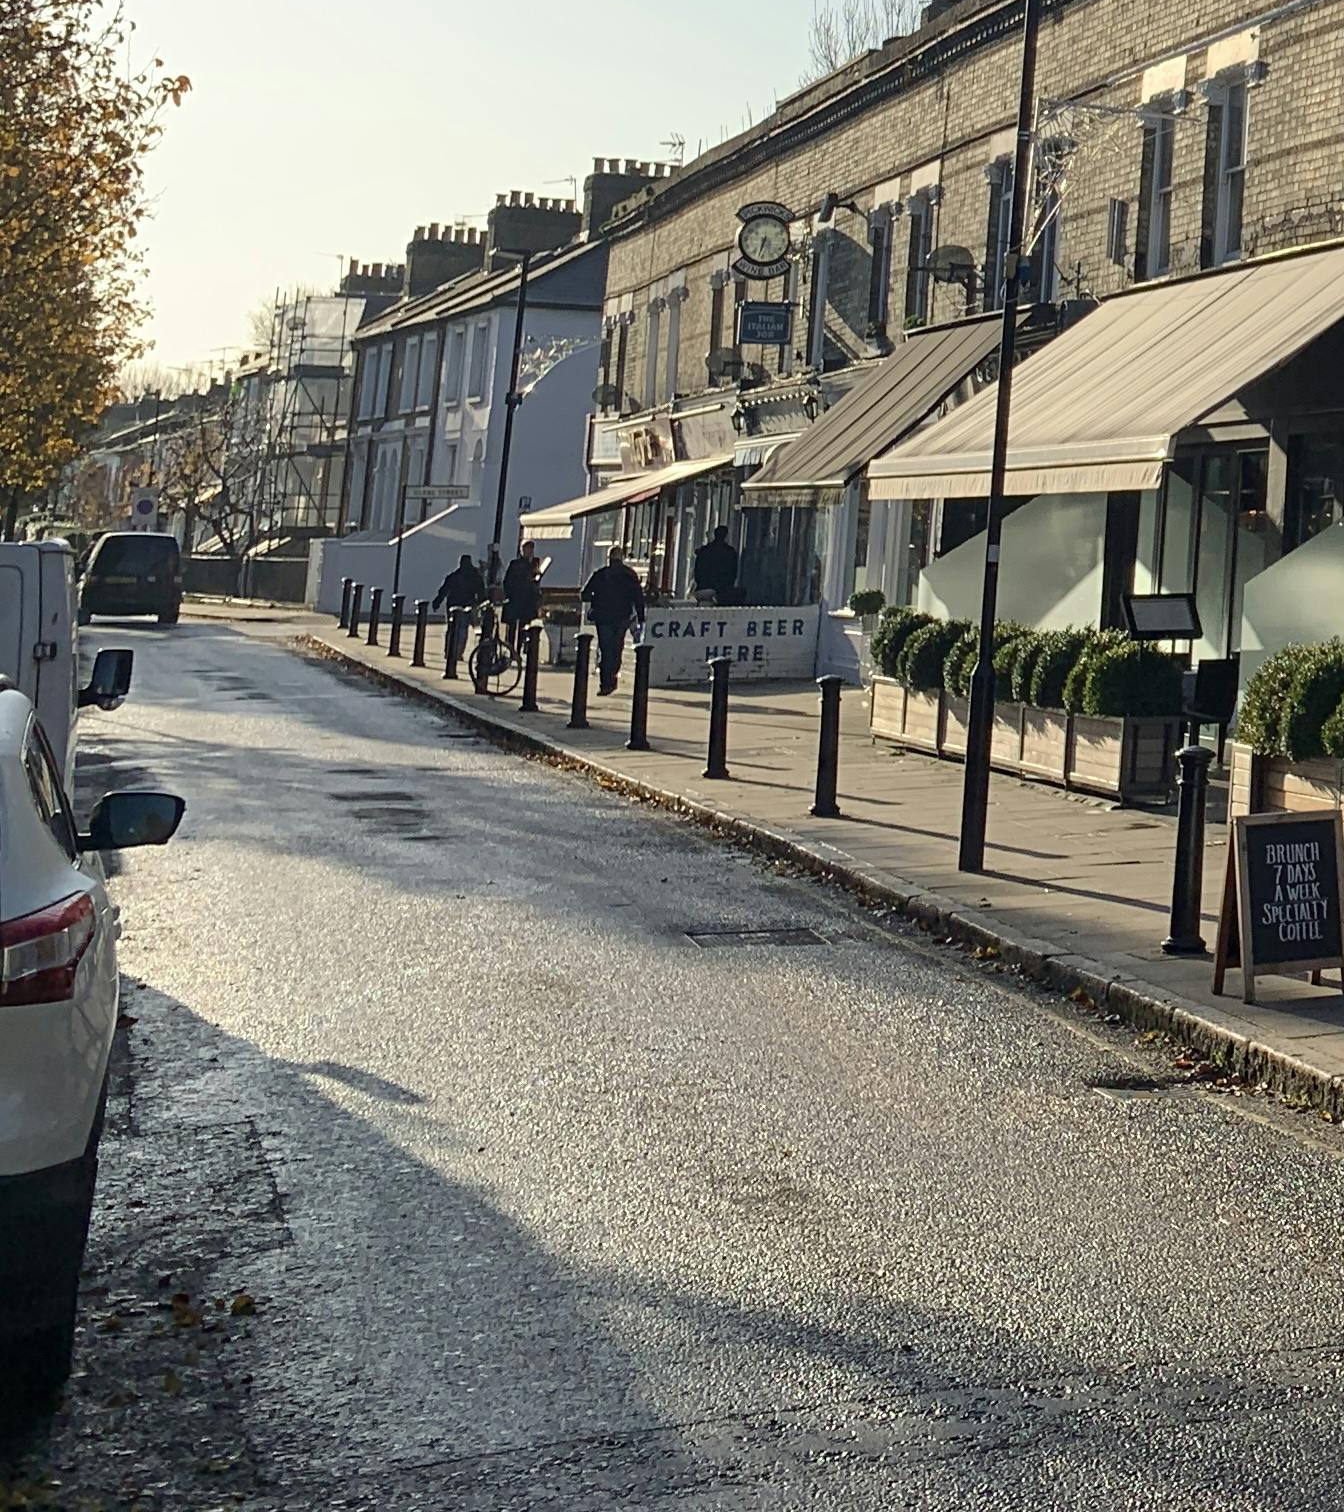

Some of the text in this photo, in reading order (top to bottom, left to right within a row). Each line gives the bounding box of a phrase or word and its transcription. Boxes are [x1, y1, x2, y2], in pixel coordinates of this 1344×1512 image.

[739, 261, 788, 275] WINE BAR
[748, 322, 784, 331] ITALIAN
[651, 619, 804, 638] CRAFT BEER
[705, 645, 764, 662] HERE
[1265, 842, 1319, 864] BRUNCH
[1273, 862, 1316, 884] 7 DAYS
[1275, 882, 1320, 901] A WEEK
[1262, 899, 1328, 925] SPECIALTY
[1279, 921, 1322, 942] COFFEE
